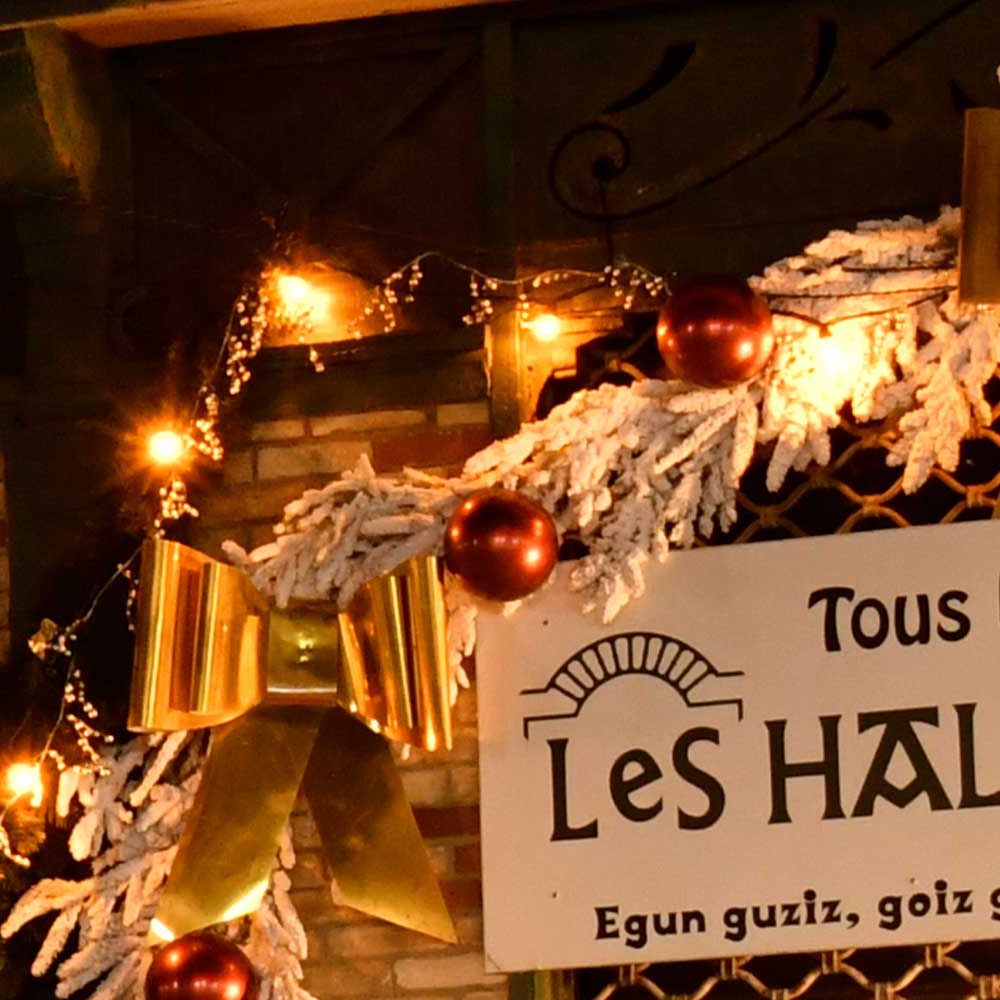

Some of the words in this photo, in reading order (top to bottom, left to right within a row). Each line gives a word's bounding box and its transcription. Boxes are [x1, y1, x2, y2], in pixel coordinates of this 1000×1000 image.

[807, 586, 971, 653] Tous
[594, 905, 706, 950] Egun
[723, 889, 860, 942] guziz,
[877, 879, 973, 931] goiz
